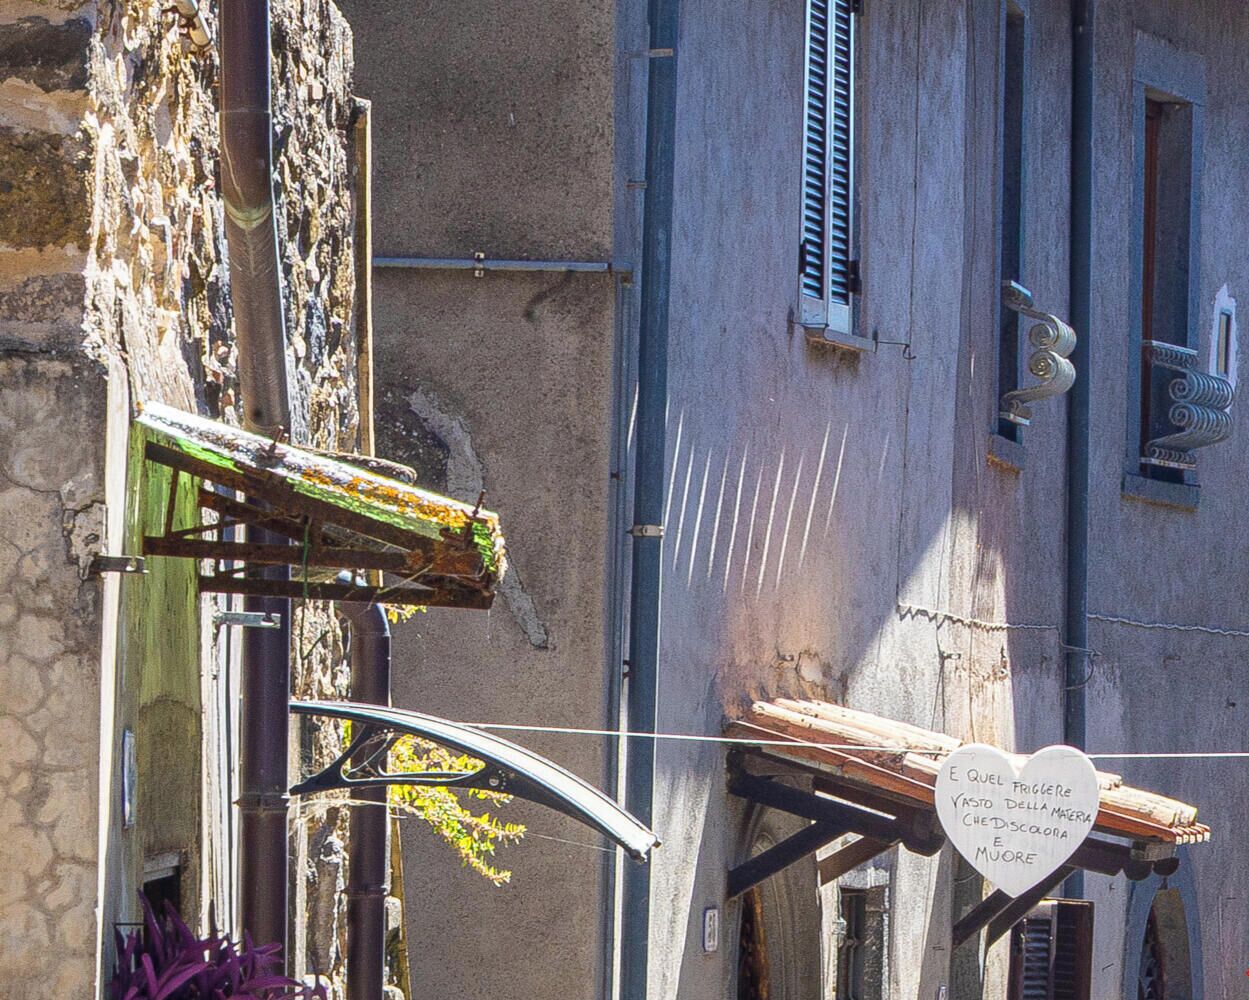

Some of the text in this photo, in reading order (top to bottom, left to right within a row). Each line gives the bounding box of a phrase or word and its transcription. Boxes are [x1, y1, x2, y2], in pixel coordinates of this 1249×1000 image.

[950, 766, 1072, 798] E QUEL FRIGGERE
[951, 793, 993, 808] VASTO
[1005, 798, 1048, 810] DELLA
[962, 813, 989, 826] CHE
[994, 837, 1003, 847] E
[975, 847, 1037, 864] MUORE
